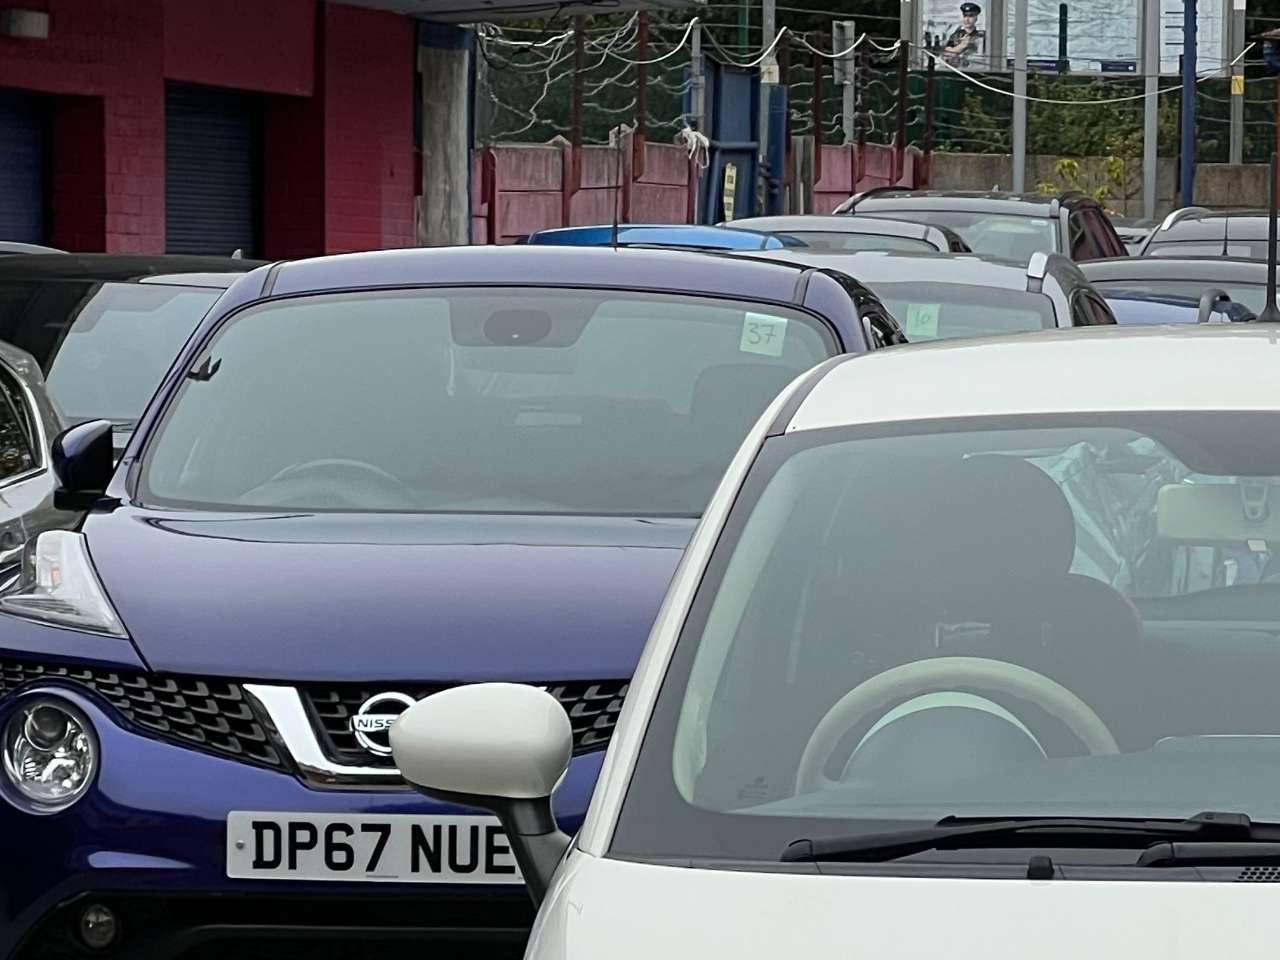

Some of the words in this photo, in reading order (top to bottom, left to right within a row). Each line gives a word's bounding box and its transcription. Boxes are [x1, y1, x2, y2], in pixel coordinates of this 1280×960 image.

[748, 322, 777, 345] 37
[358, 719, 394, 728] NISS
[251, 820, 392, 873] DP67
[410, 823, 516, 875] NUE
